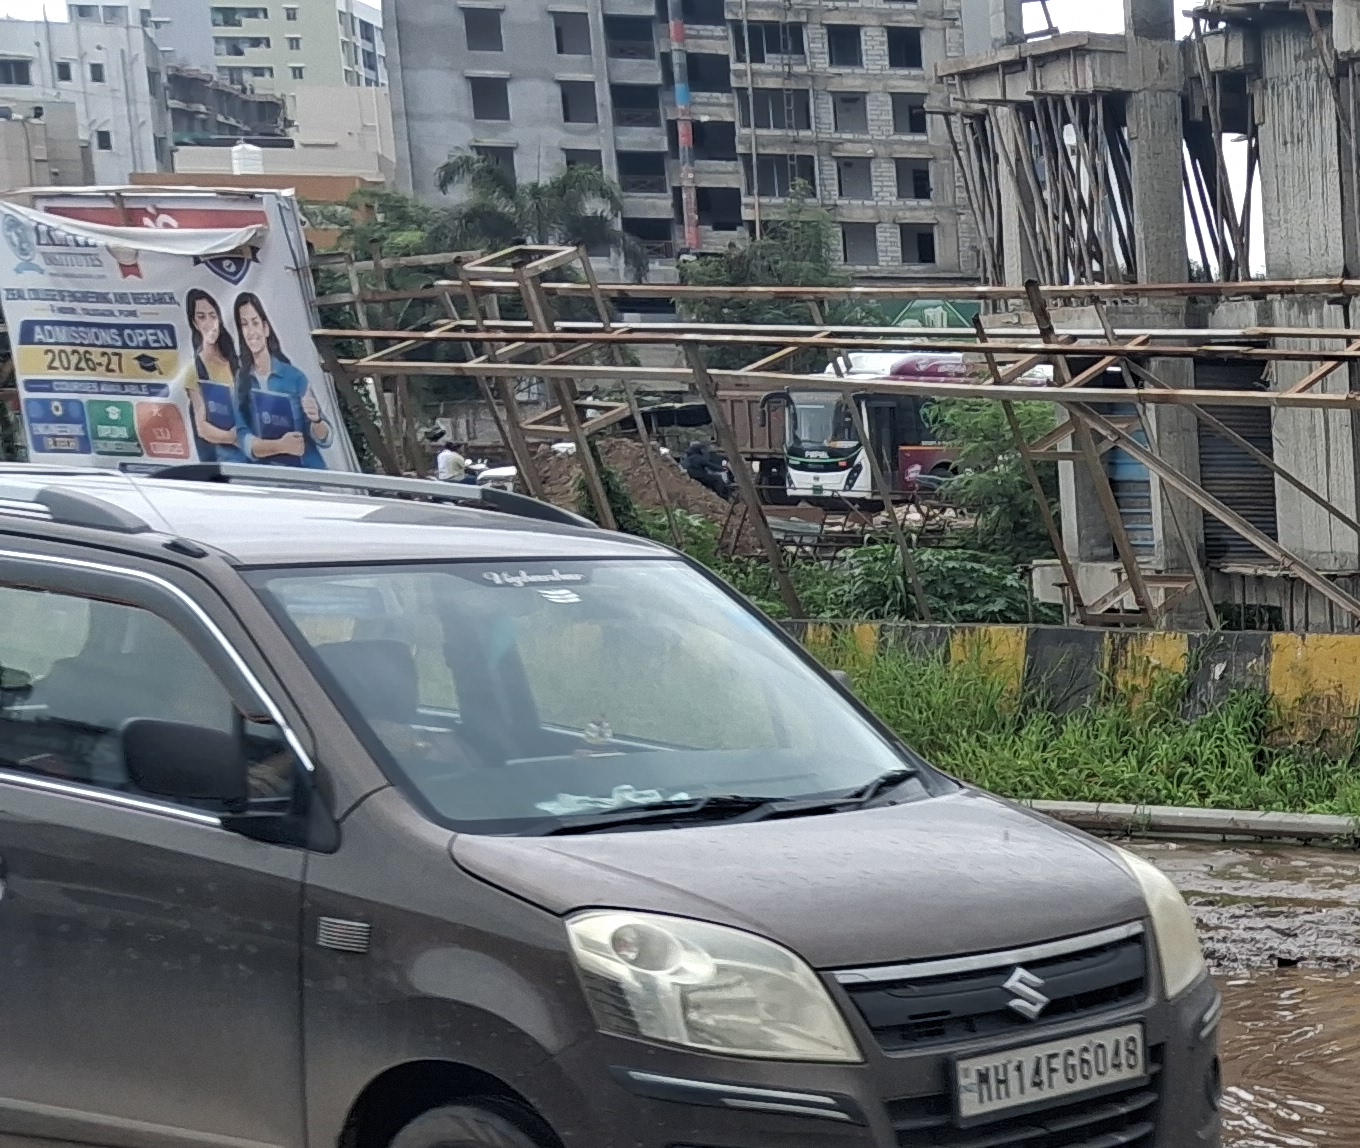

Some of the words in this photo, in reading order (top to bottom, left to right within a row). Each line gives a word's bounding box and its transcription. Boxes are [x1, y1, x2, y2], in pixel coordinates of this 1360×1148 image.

[33, 325, 122, 346] ADMISSIONS
[123, 329, 173, 347] OPEN
[44, 349, 123, 373] 2026-27
[974, 1035, 1138, 1104] MH14FG6048
